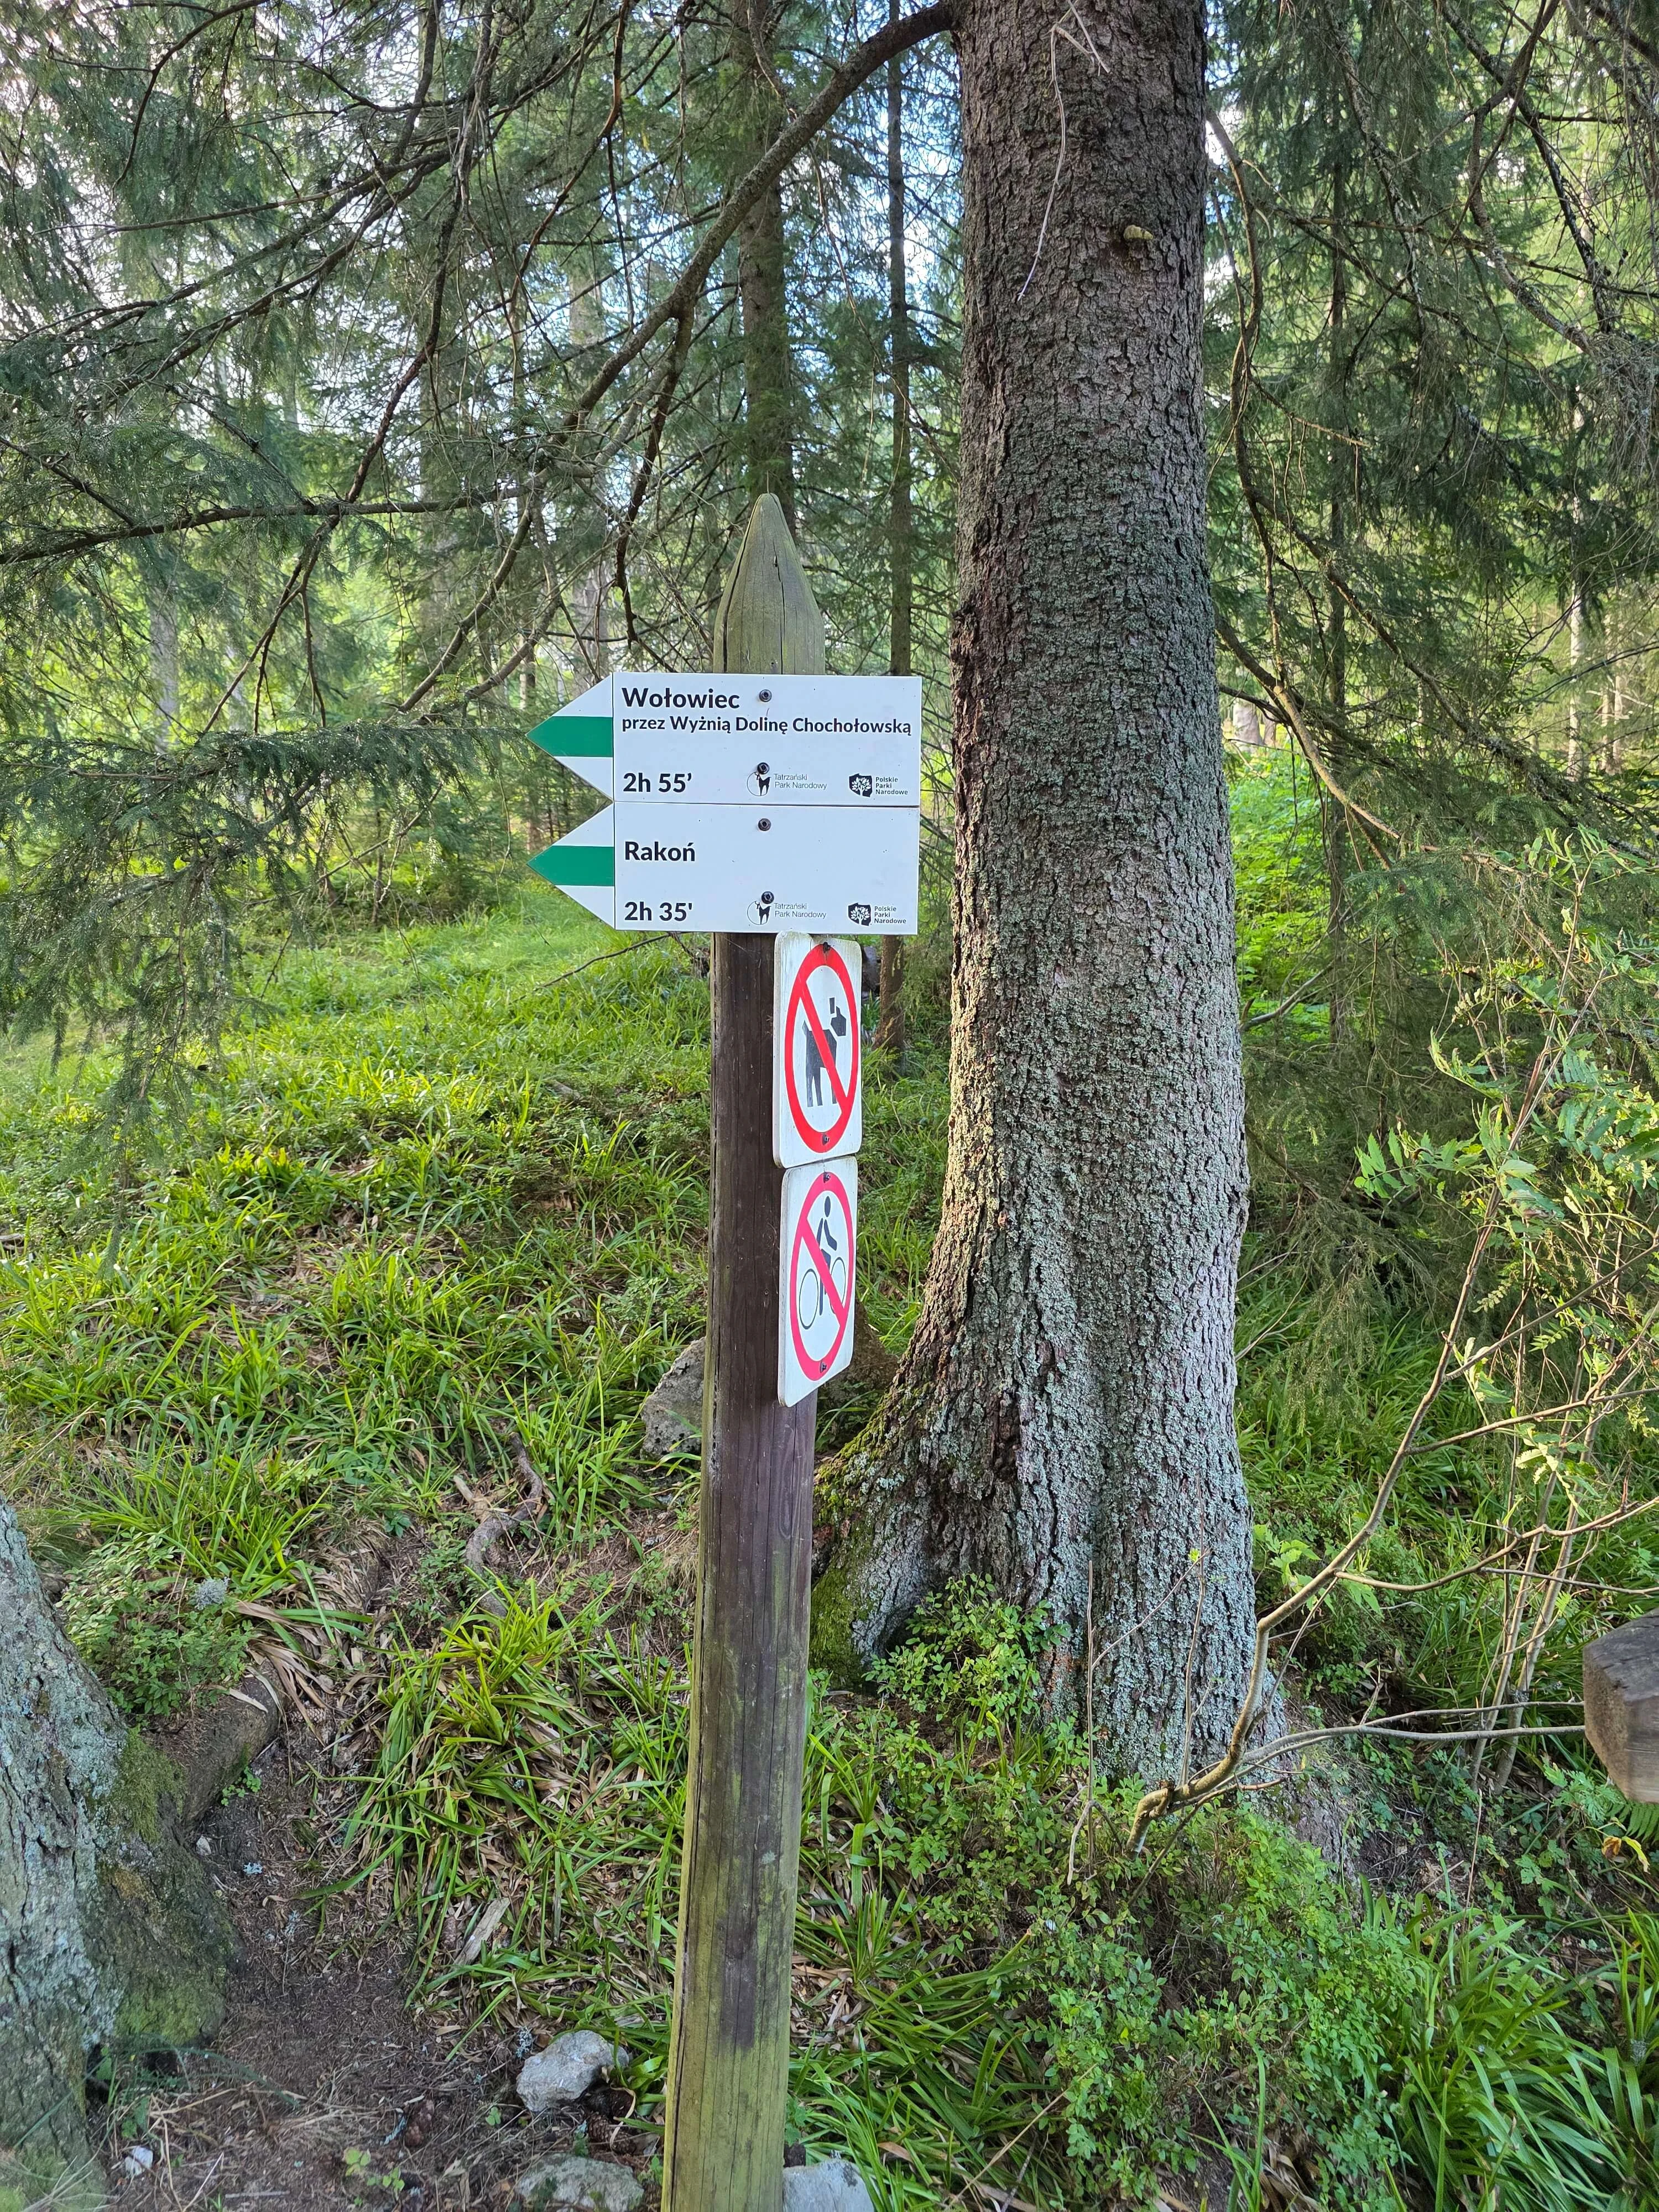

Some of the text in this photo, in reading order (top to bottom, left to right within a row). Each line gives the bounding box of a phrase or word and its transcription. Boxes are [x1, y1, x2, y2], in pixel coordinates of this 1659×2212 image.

[621, 687, 740, 709] Wołowiec
[622, 716, 911, 736] przez Wyżnią Dolinę Chochołowską
[623, 772, 651, 792] 2h
[792, 781, 827, 790] Narodowy
[625, 841, 695, 862] Rakoń
[624, 901, 652, 921] 2h
[792, 911, 827, 920] Narodowy
